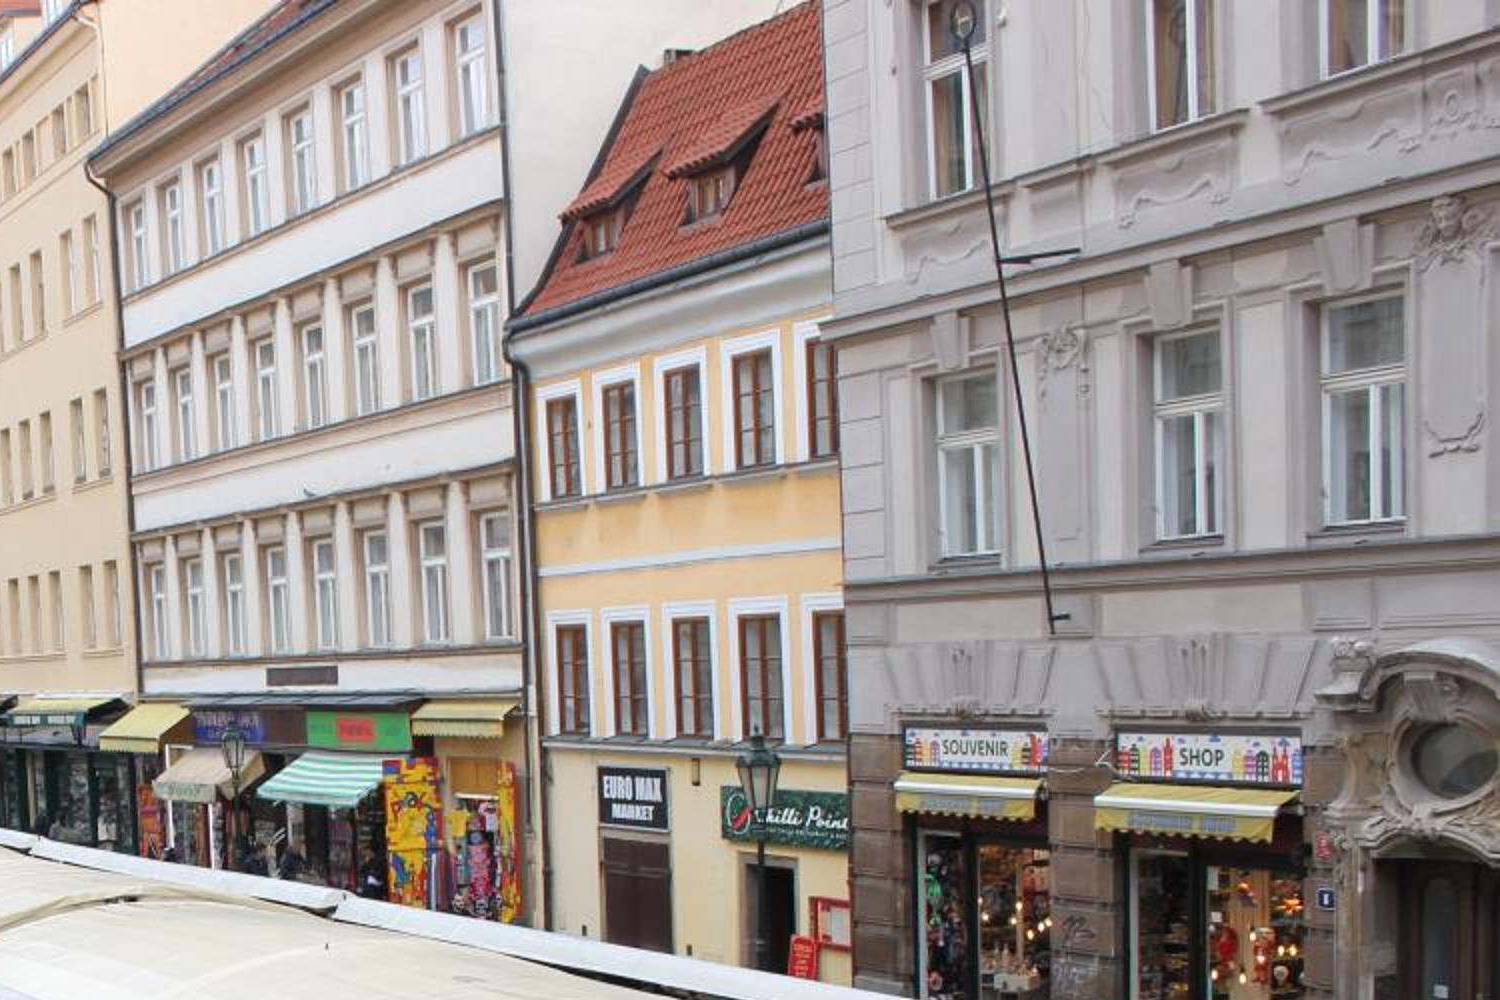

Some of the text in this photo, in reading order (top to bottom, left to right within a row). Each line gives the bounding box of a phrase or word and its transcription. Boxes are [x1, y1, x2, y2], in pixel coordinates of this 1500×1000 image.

[942, 740, 1009, 757] SOUVENIR
[1179, 748, 1224, 767] SHOP
[603, 775, 663, 803] EURO MAX
[611, 803, 655, 821] MARKET
[805, 805, 850, 829] Point
